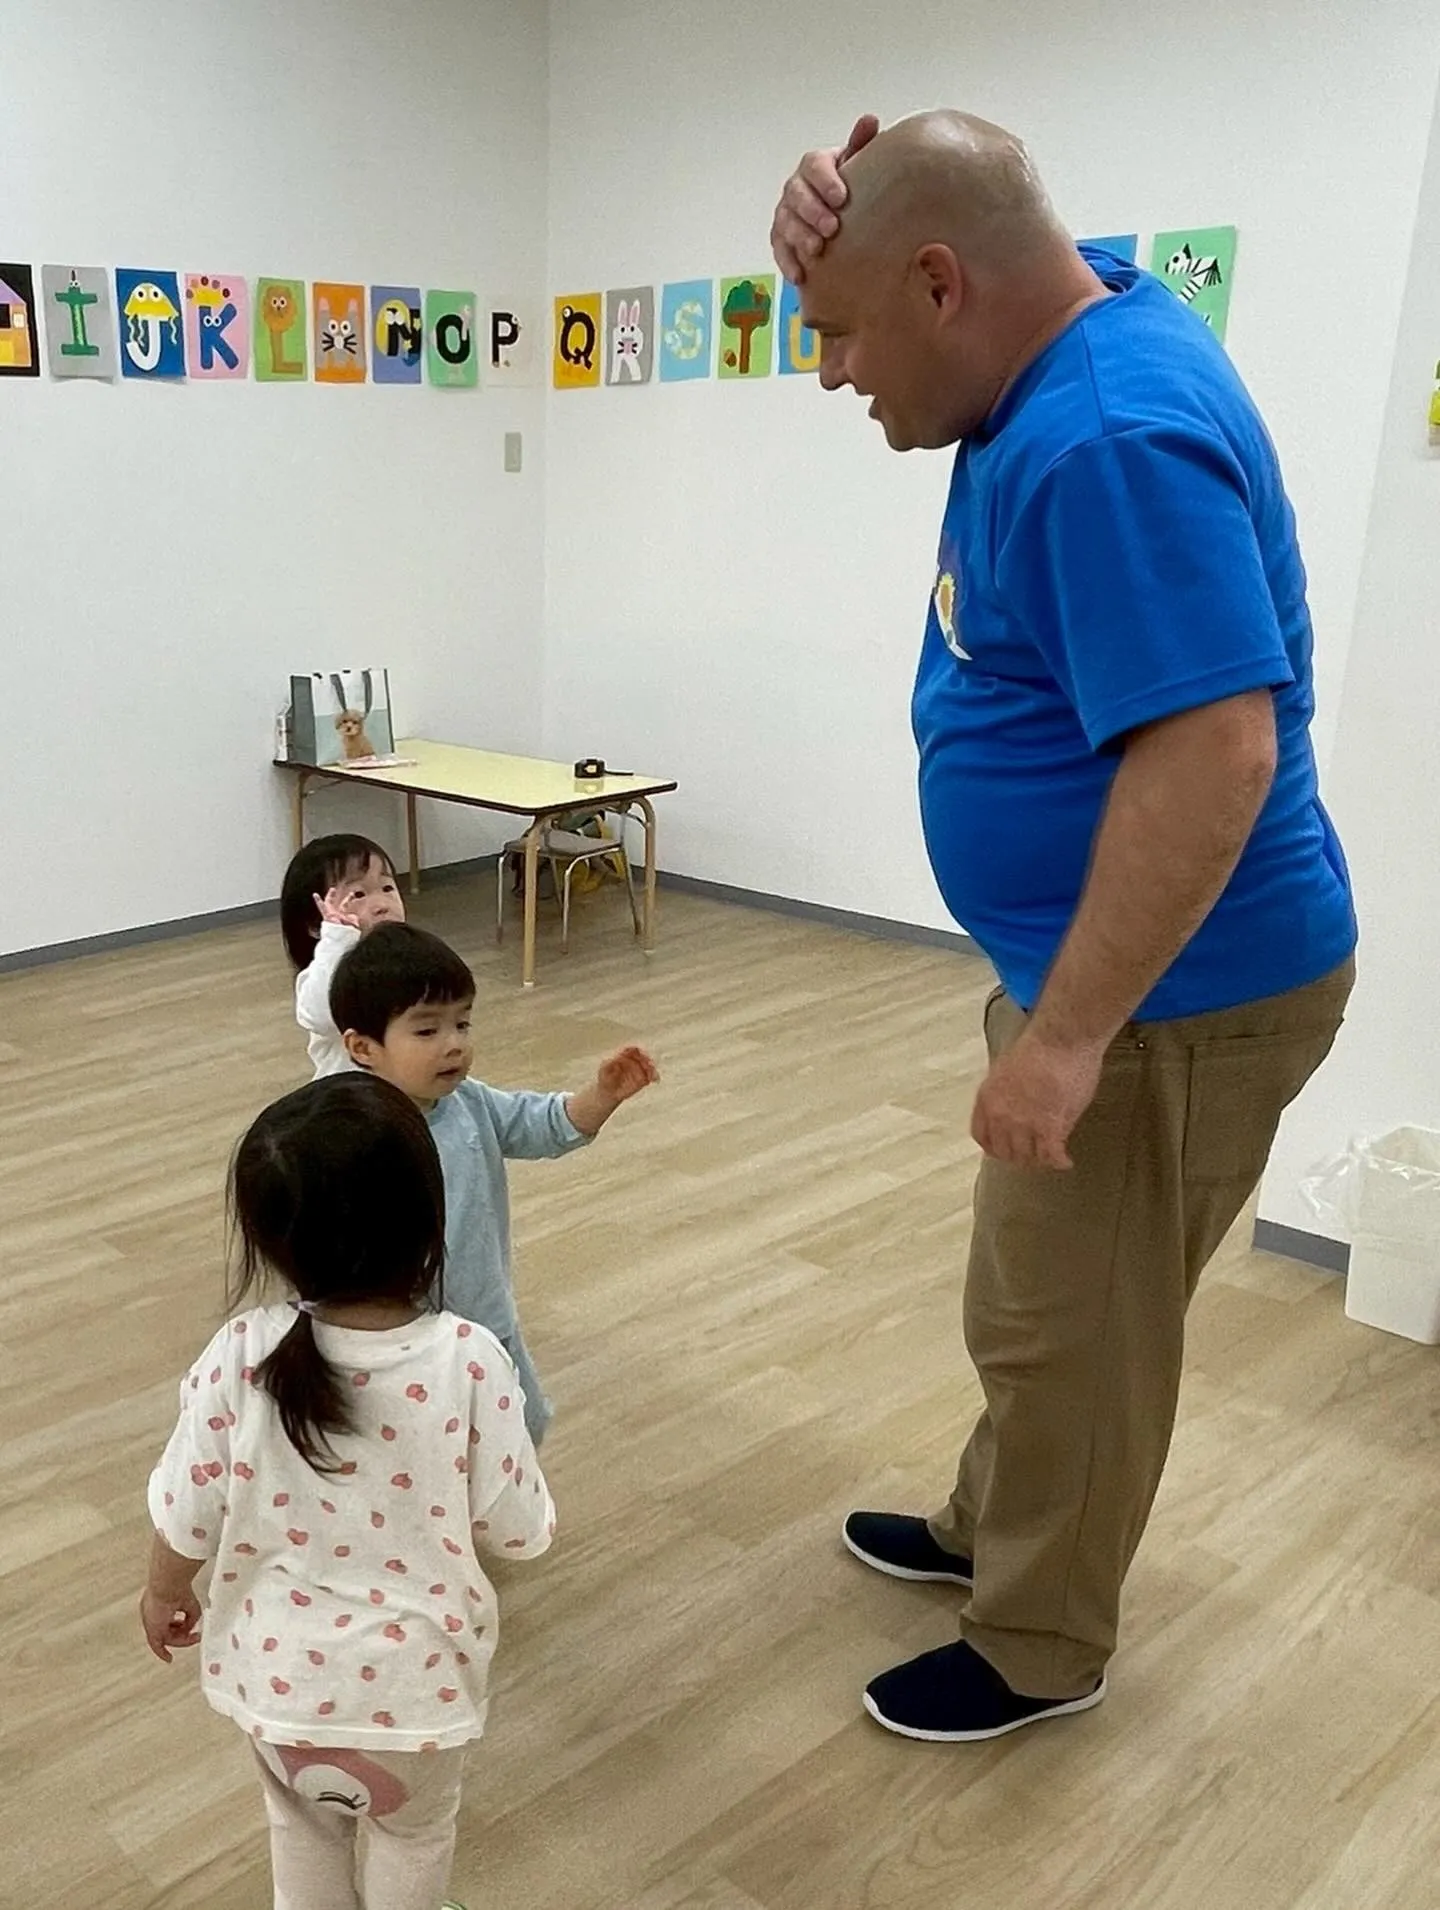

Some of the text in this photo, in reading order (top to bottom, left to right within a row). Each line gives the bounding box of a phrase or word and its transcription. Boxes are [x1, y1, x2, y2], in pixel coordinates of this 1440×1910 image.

[55, 286, 99, 356] I
[124, 297, 176, 371] J
[199, 303, 239, 370] K
[264, 286, 303, 374] L
[387, 307, 421, 356] N
[435, 313, 470, 364] O
[492, 312, 521, 366] P
[560, 308, 597, 370] Q
[611, 311, 644, 383] R
[670, 300, 704, 360] S
[724, 298, 768, 374] T
